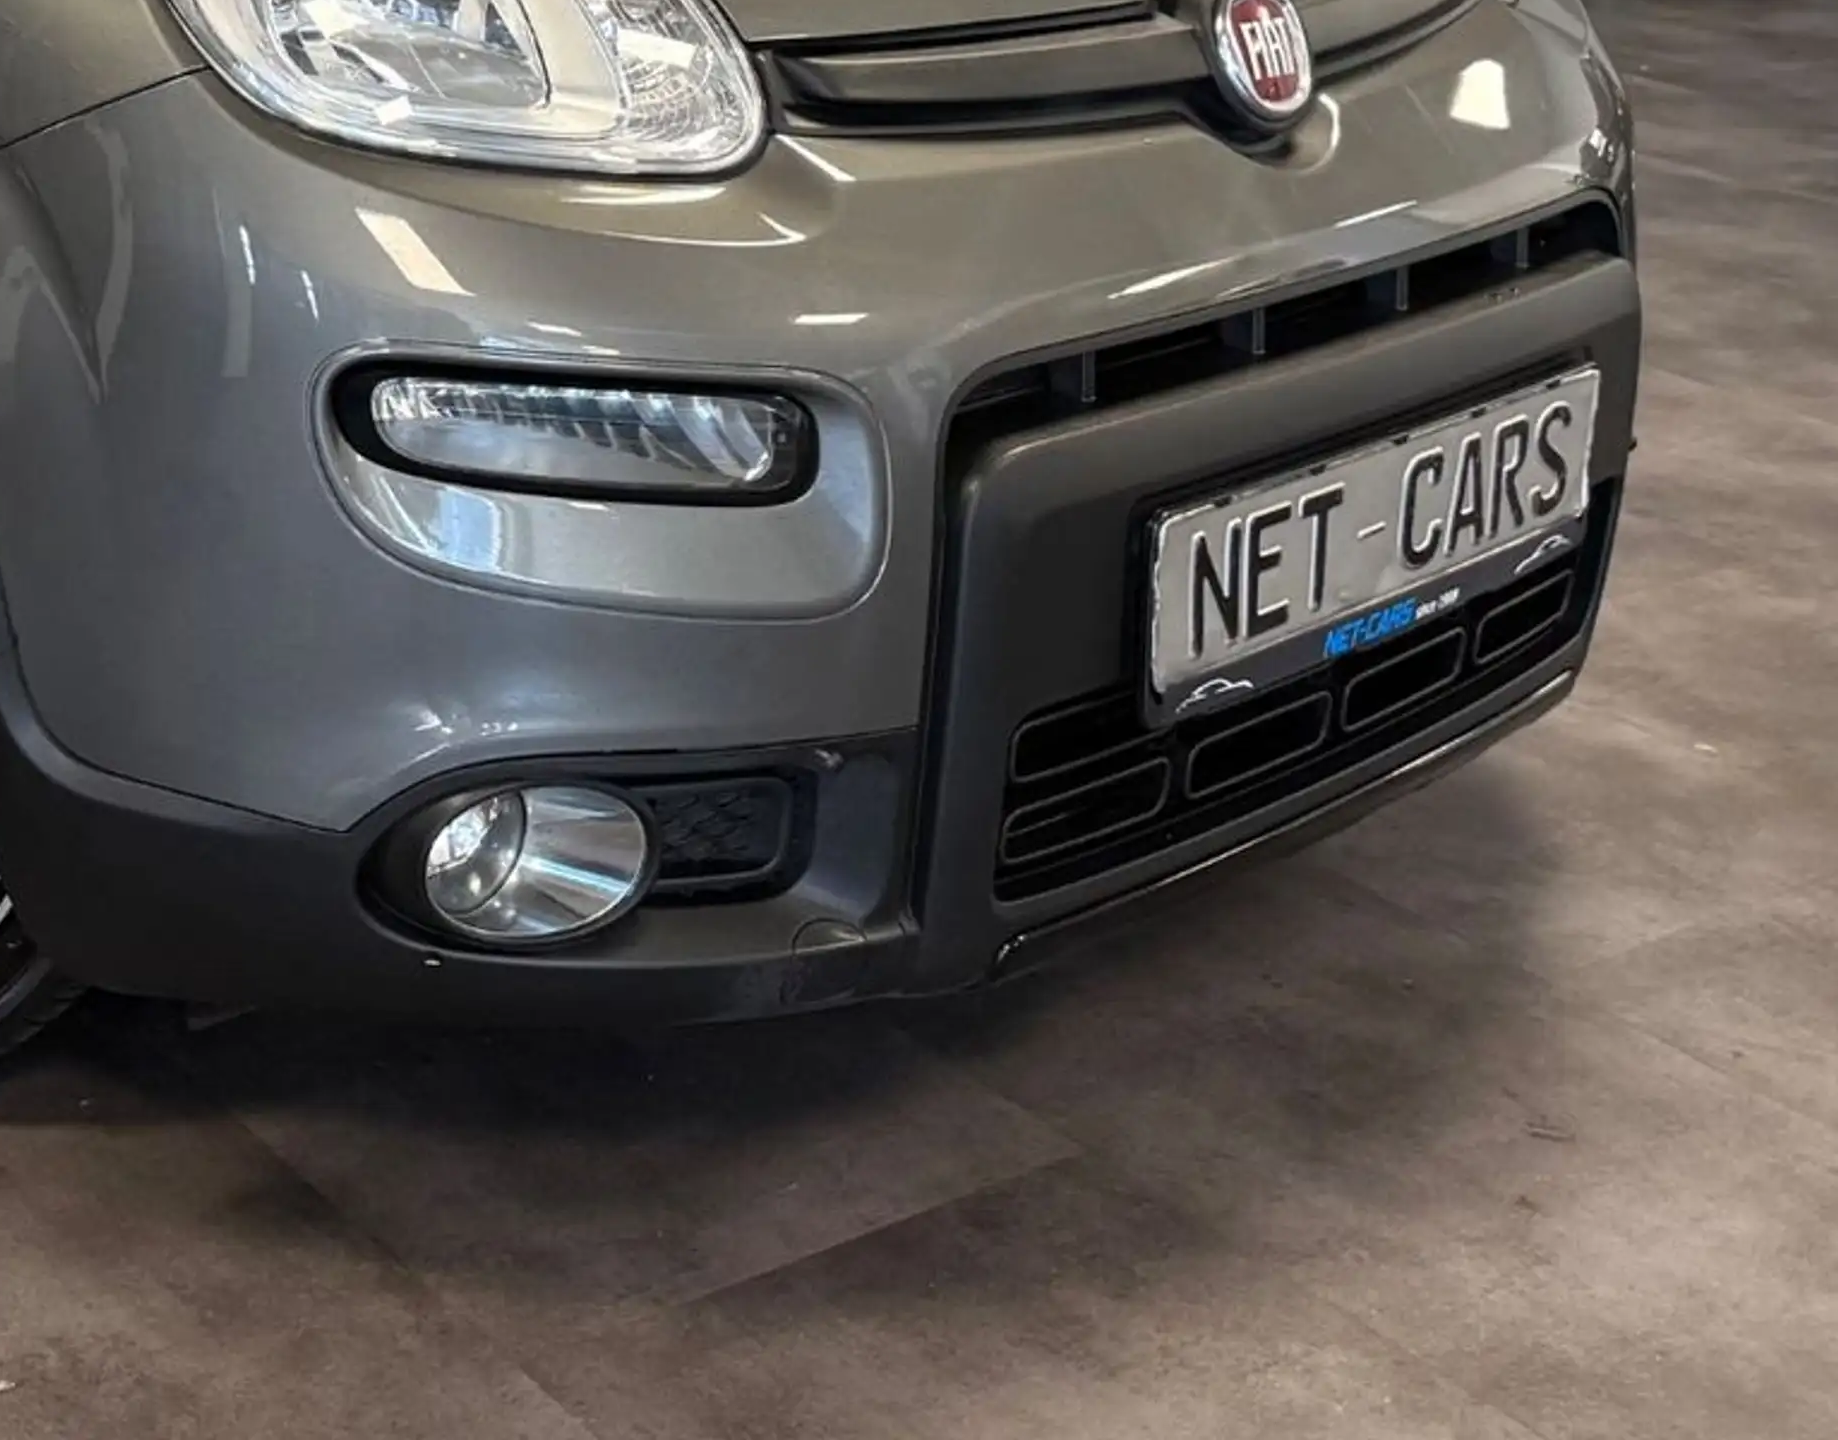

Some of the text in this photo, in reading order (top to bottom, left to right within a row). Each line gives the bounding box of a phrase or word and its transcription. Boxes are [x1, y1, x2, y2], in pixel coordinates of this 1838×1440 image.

[1238, 15, 1296, 81] FIAT
[1190, 482, 1345, 659] NET
[1396, 401, 1573, 569] CARS
